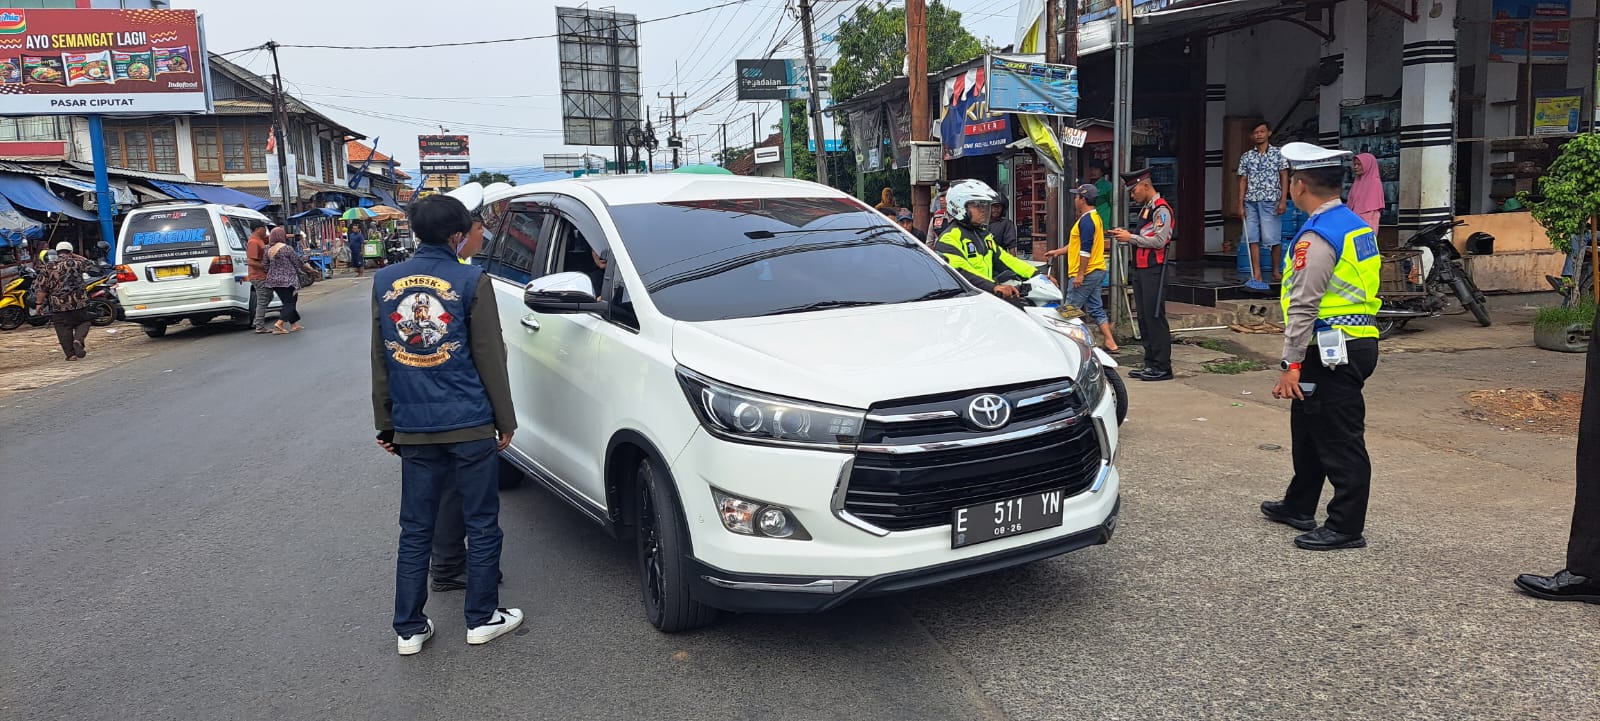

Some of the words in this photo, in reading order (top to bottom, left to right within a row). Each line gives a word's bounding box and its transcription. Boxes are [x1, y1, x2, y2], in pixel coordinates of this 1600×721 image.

[26, 34, 49, 49] AYO
[51, 32, 114, 48] SEMANGAT
[116, 31, 147, 46] LAGI!
[168, 81, 198, 89] Indofood
[51, 99, 87, 107] PASAR
[89, 98, 134, 107] CIPUTAT
[972, 122, 998, 133] FLTER
[957, 508, 968, 533] E
[994, 497, 1023, 524] 511
[1041, 490, 1060, 515] YN
